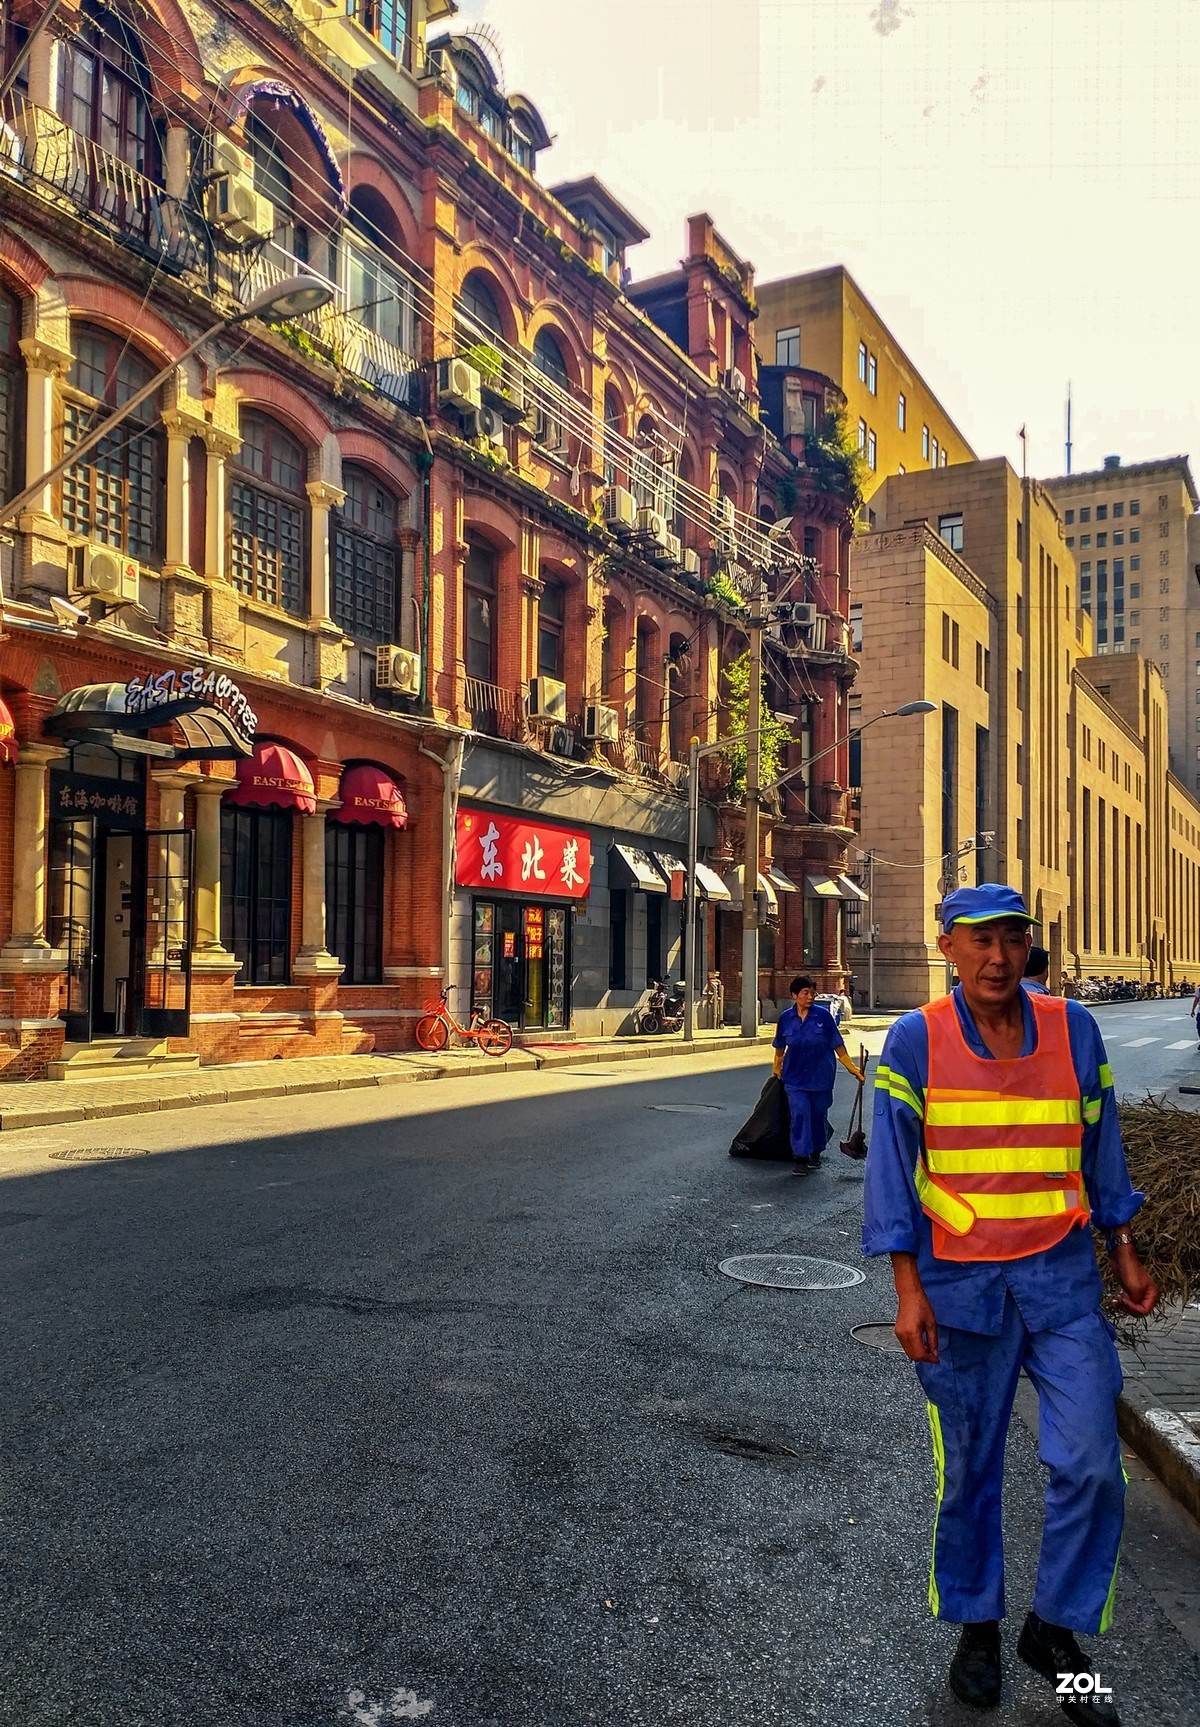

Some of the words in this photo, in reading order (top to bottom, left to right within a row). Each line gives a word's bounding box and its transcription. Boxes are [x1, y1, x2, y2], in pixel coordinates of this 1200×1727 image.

[125, 670, 176, 707] EAST
[180, 667, 215, 694] SEA
[215, 674, 258, 734] COFFEE
[253, 776, 285, 787] EAST
[58, 786, 139, 816] 东海咖啡馆
[354, 796, 382, 808] EAST
[478, 821, 585, 891] 东北菜
